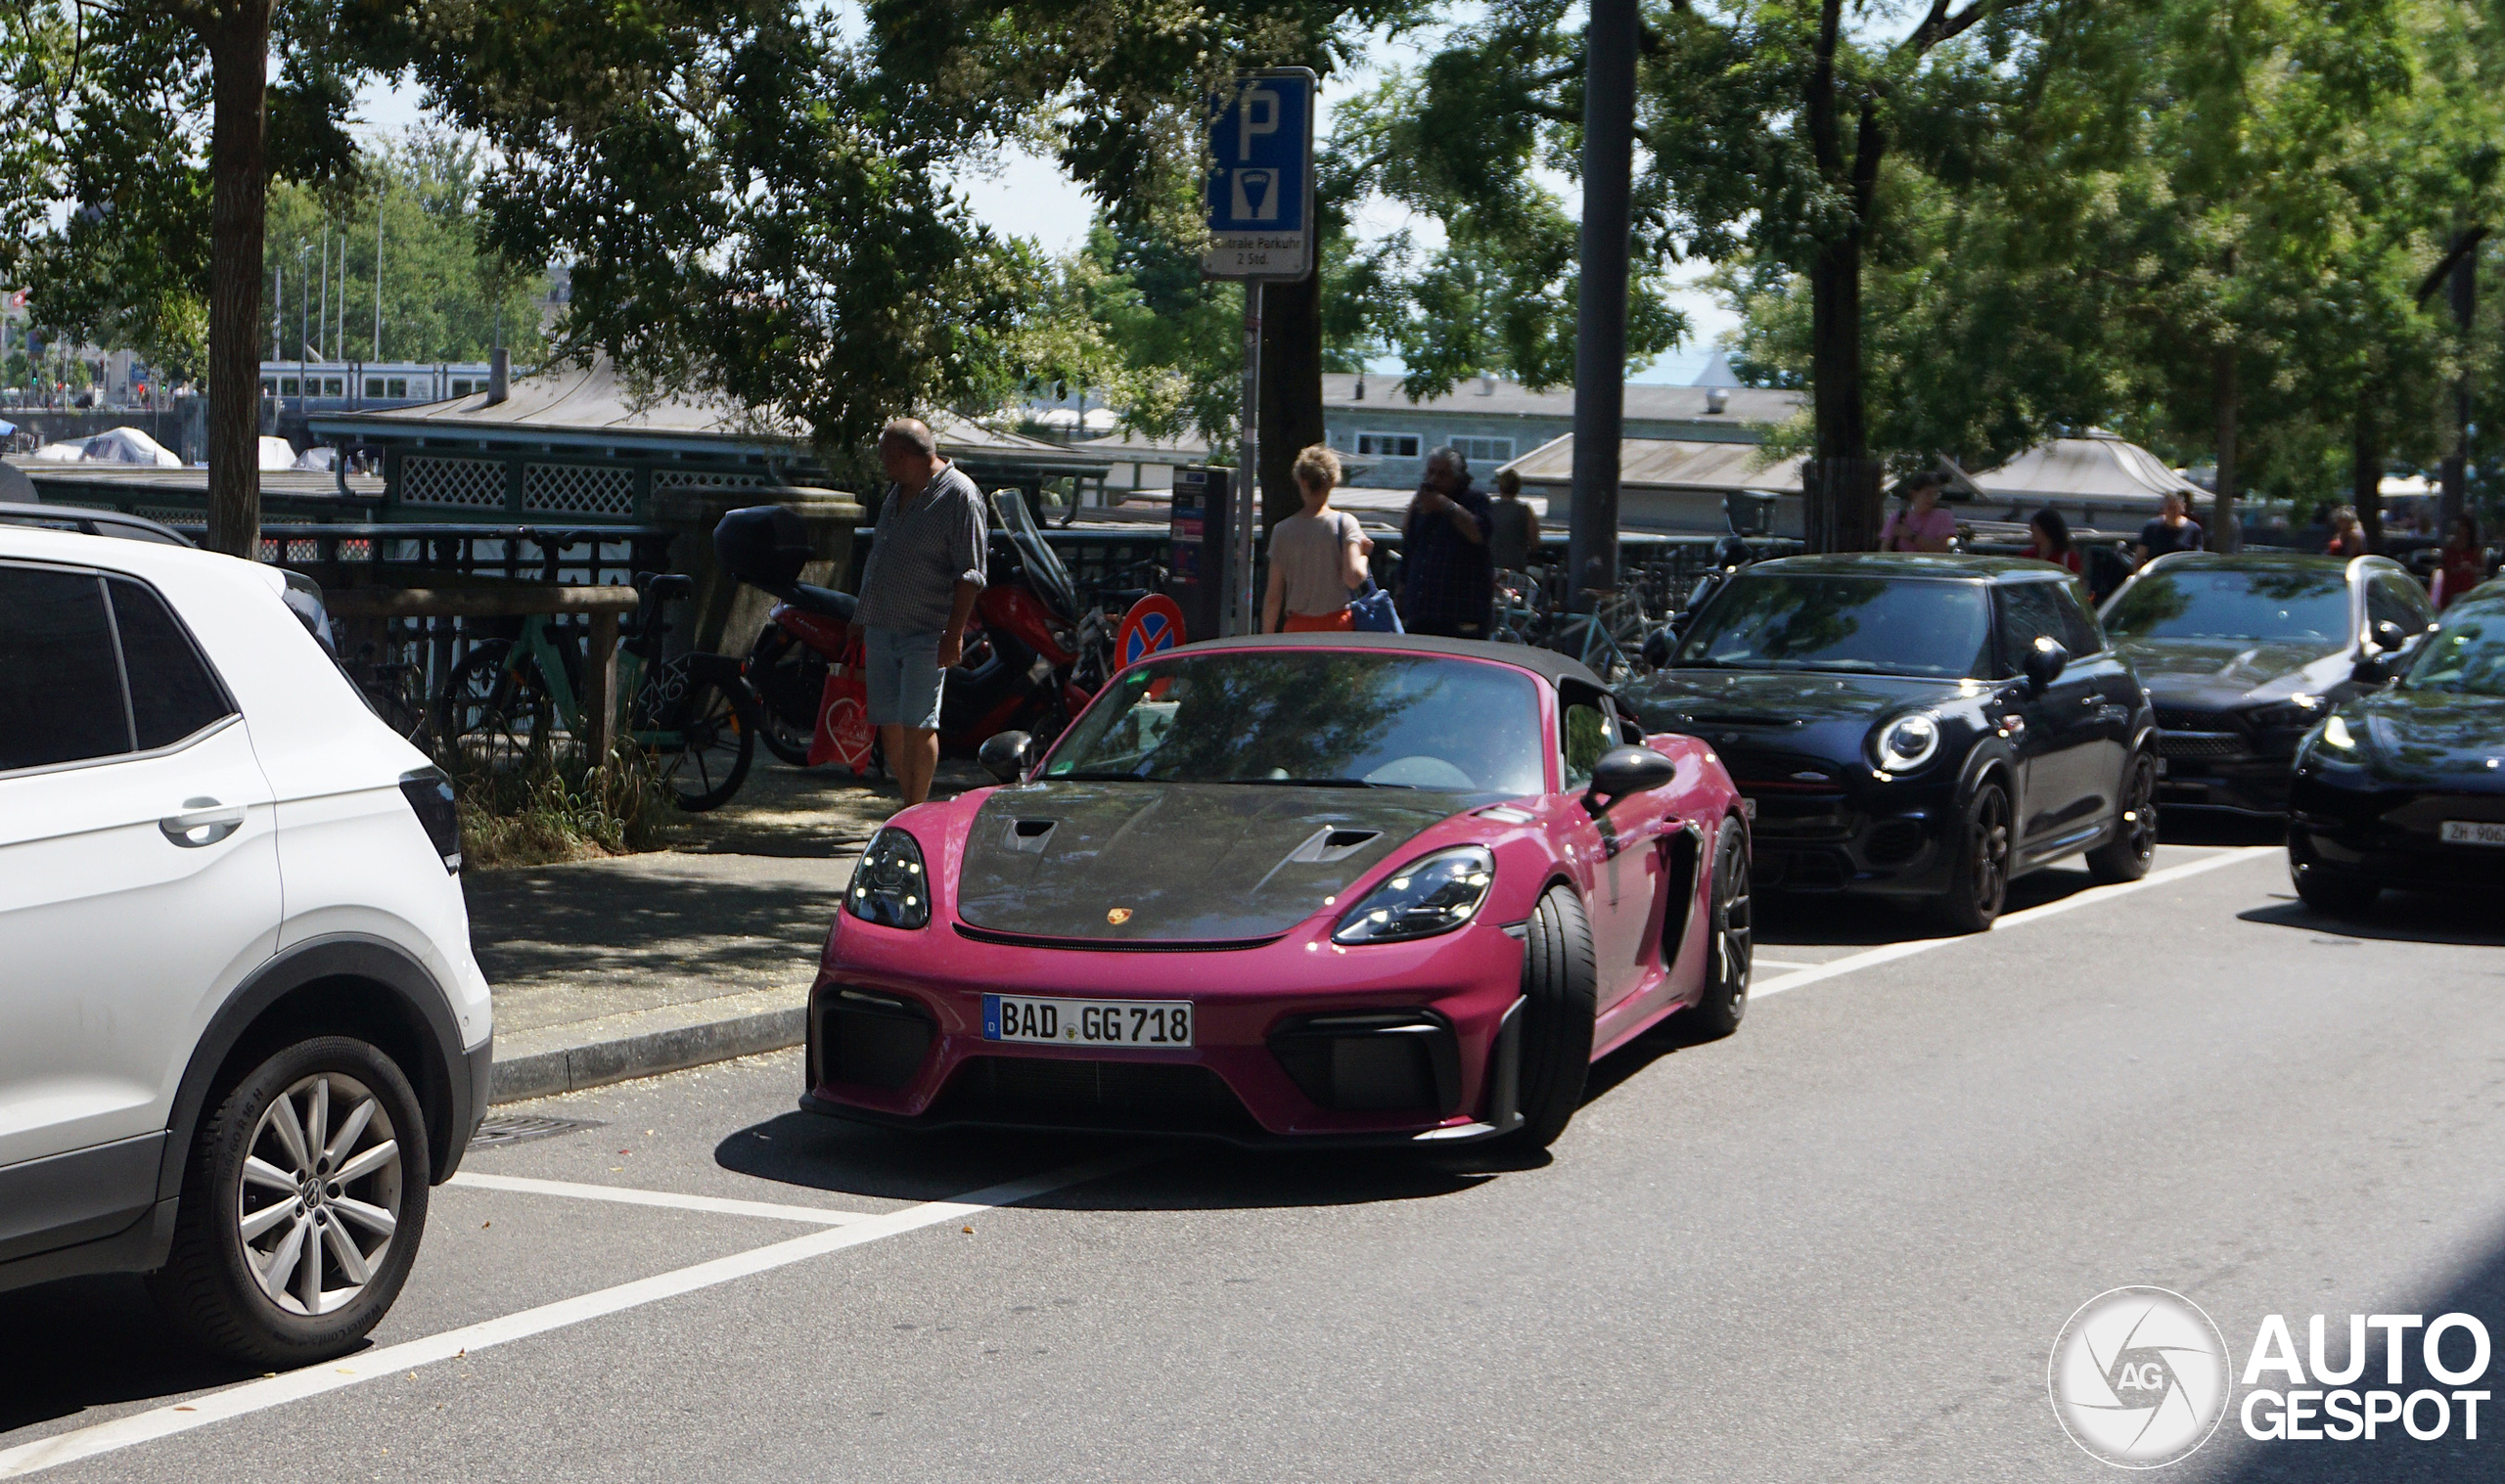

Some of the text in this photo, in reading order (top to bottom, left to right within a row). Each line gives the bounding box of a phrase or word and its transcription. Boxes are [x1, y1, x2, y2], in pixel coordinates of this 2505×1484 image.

[1239, 89, 1280, 160] P
[1258, 237, 1300, 249] Parkuhr
[1237, 252, 1269, 265] 2 Std.
[2451, 823, 2468, 839] ZH
[988, 1021, 995, 1032] D
[1002, 1002, 1189, 1042] BAD GG 718
